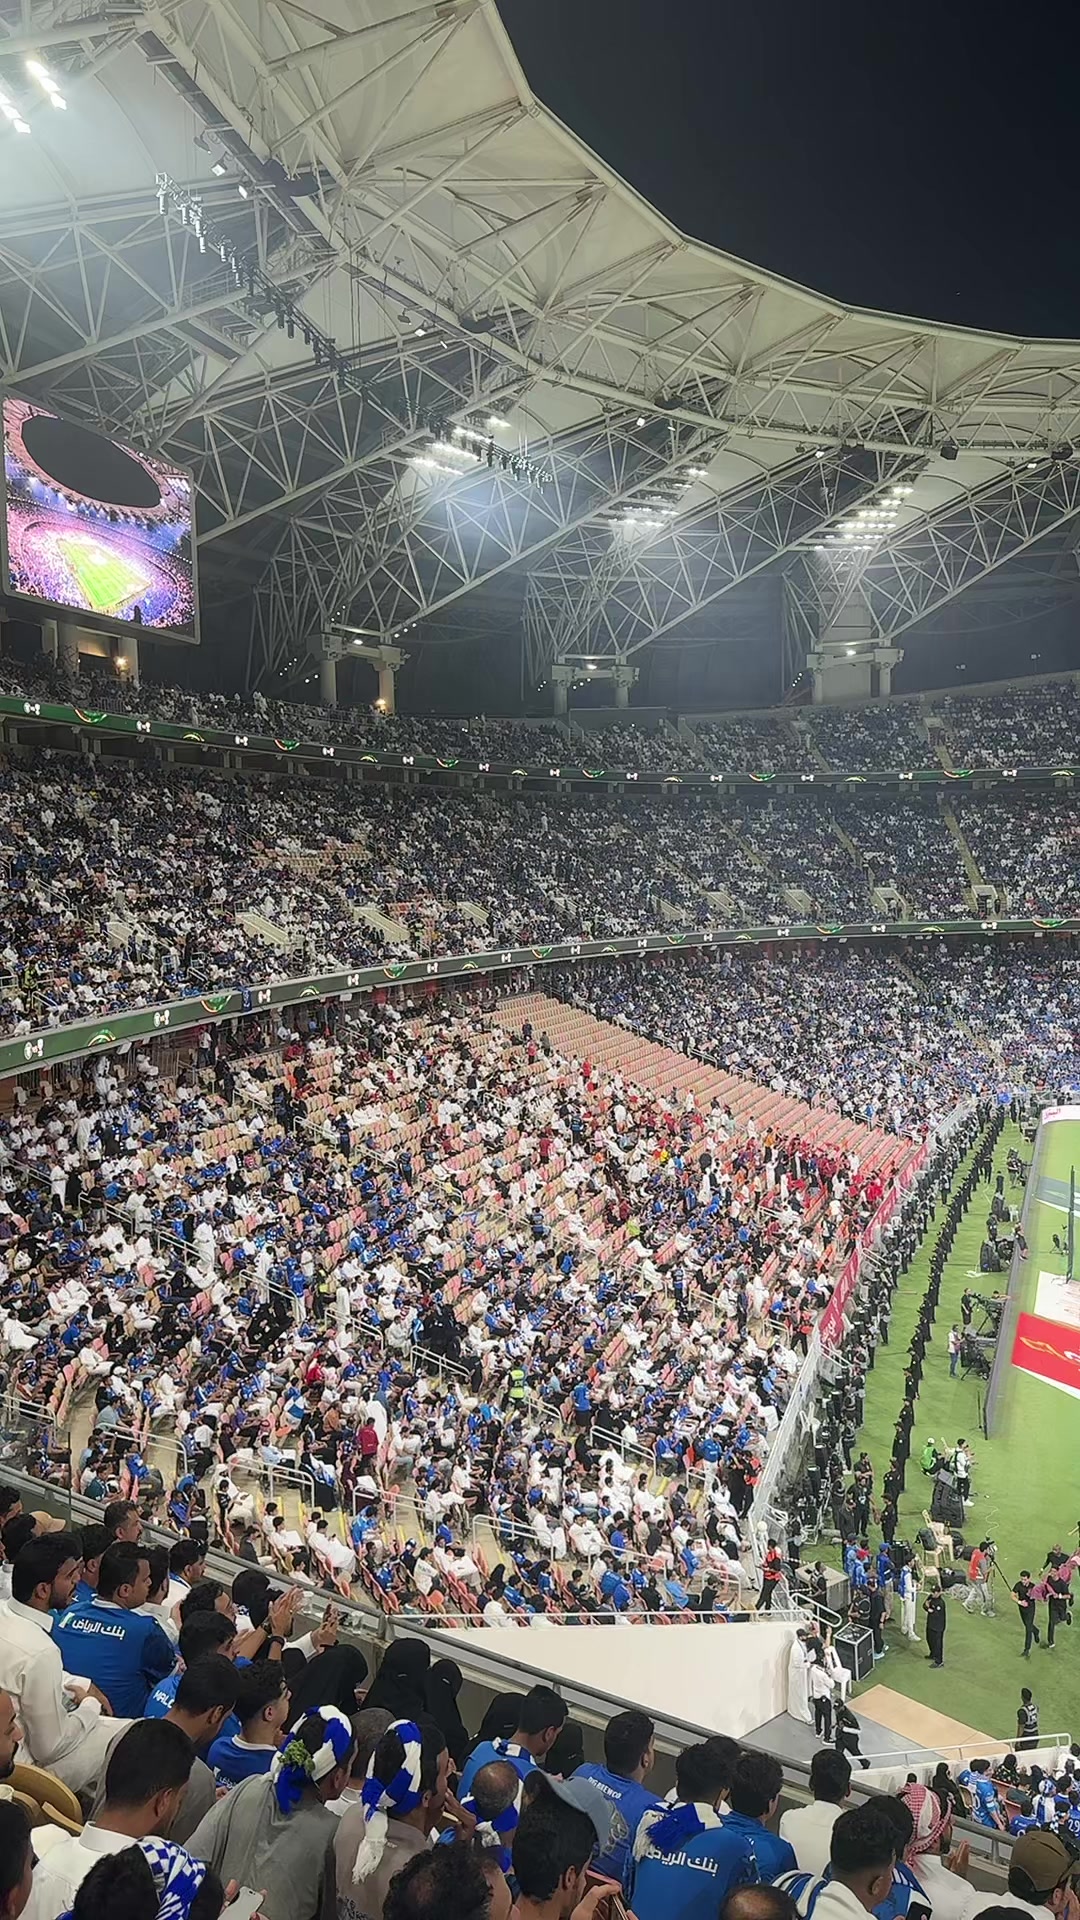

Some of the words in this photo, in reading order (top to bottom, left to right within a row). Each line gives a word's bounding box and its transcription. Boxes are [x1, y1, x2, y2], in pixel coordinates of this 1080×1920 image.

[72, 1618, 101, 1633] الرياض
[100, 1625, 126, 1640] بنك
[152, 1689, 175, 1708] MALC
[687, 1856, 719, 1877] بنك
